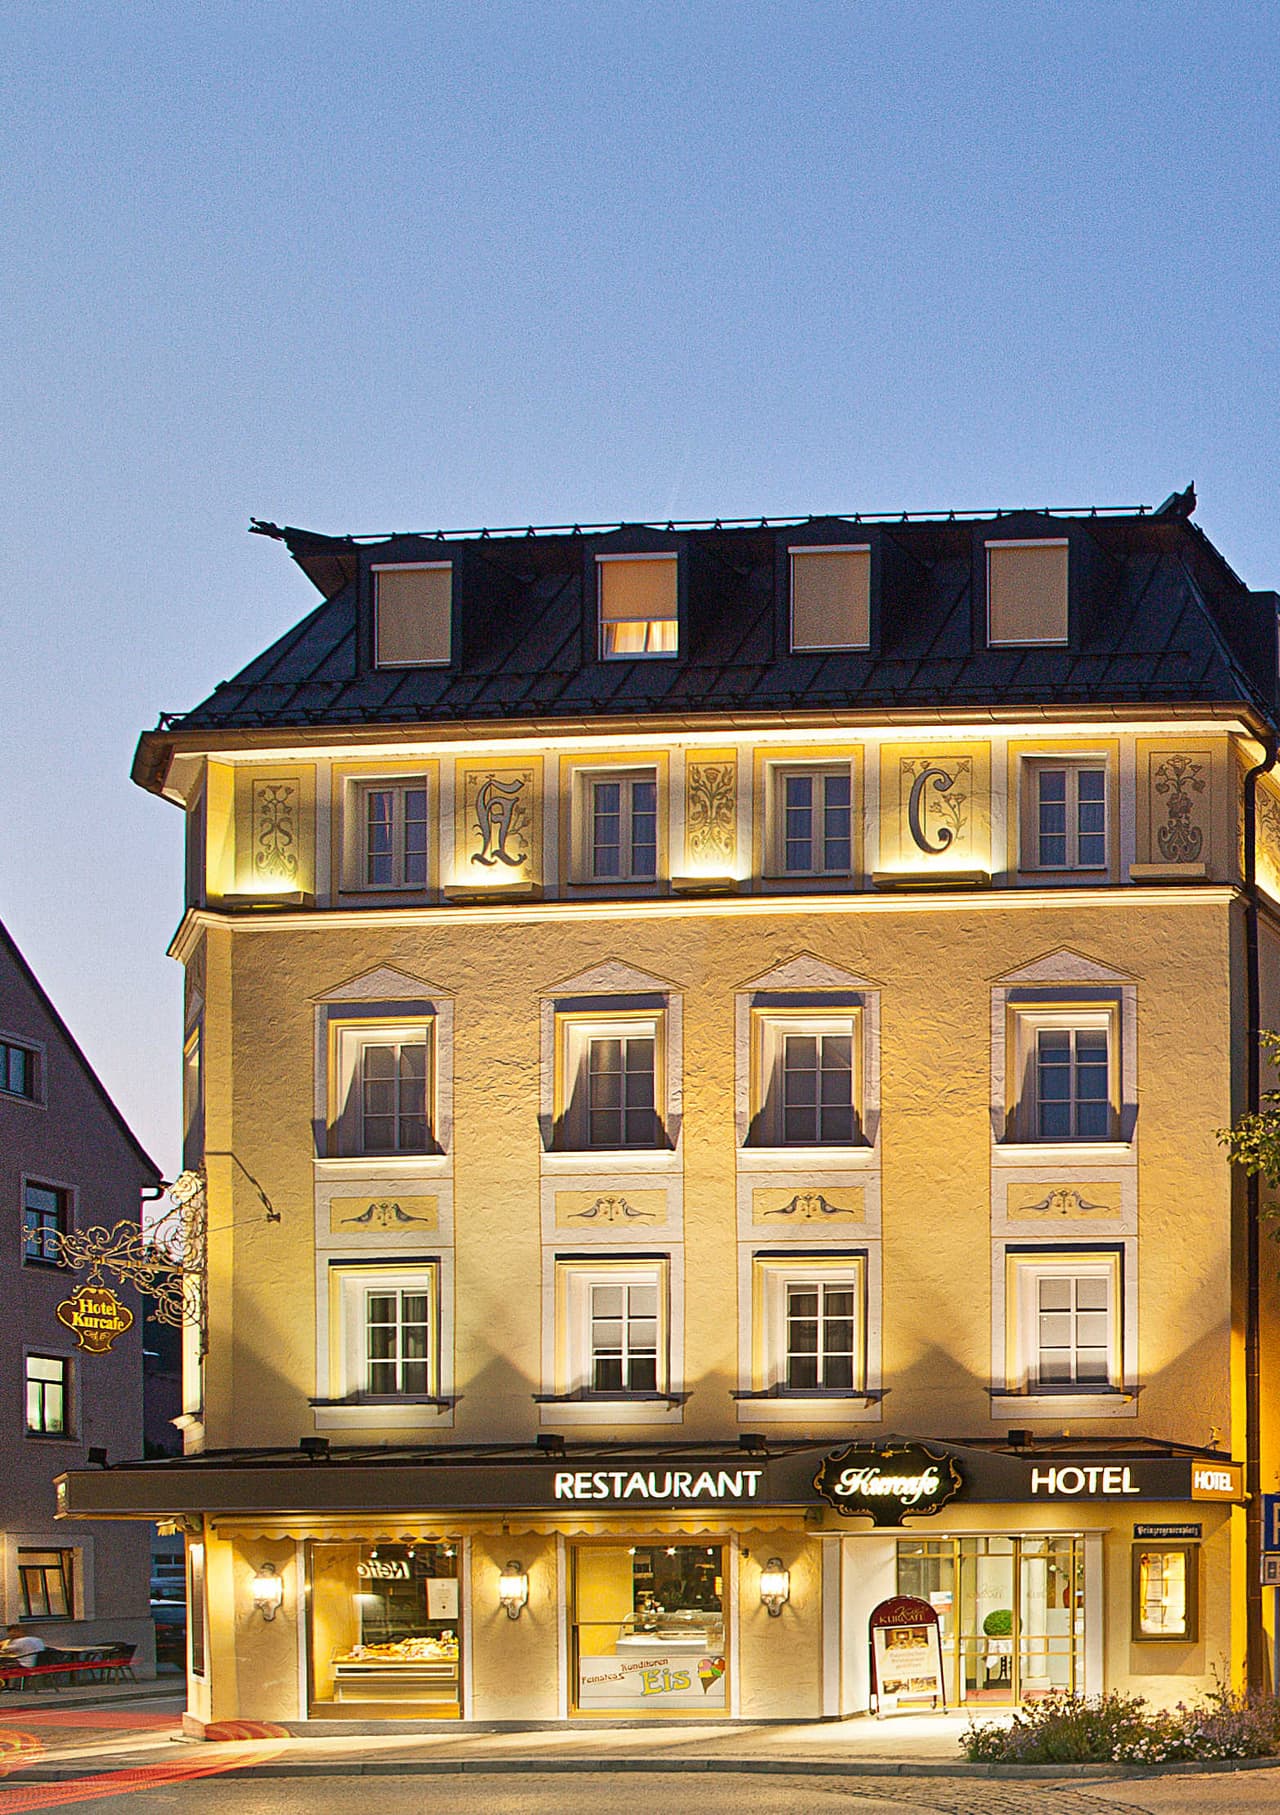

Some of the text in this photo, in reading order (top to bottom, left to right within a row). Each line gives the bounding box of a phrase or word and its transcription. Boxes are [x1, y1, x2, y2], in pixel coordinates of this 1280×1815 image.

[72, 1312, 125, 1331] Kurcafe
[79, 1299, 117, 1316] Hotel
[555, 1470, 763, 1499] RESTAURANT
[834, 1466, 940, 1505] Kurcafe
[1031, 1466, 1141, 1494] HOTEL
[1194, 1470, 1234, 1492] HOTEL
[640, 1668, 691, 1696] Eis
